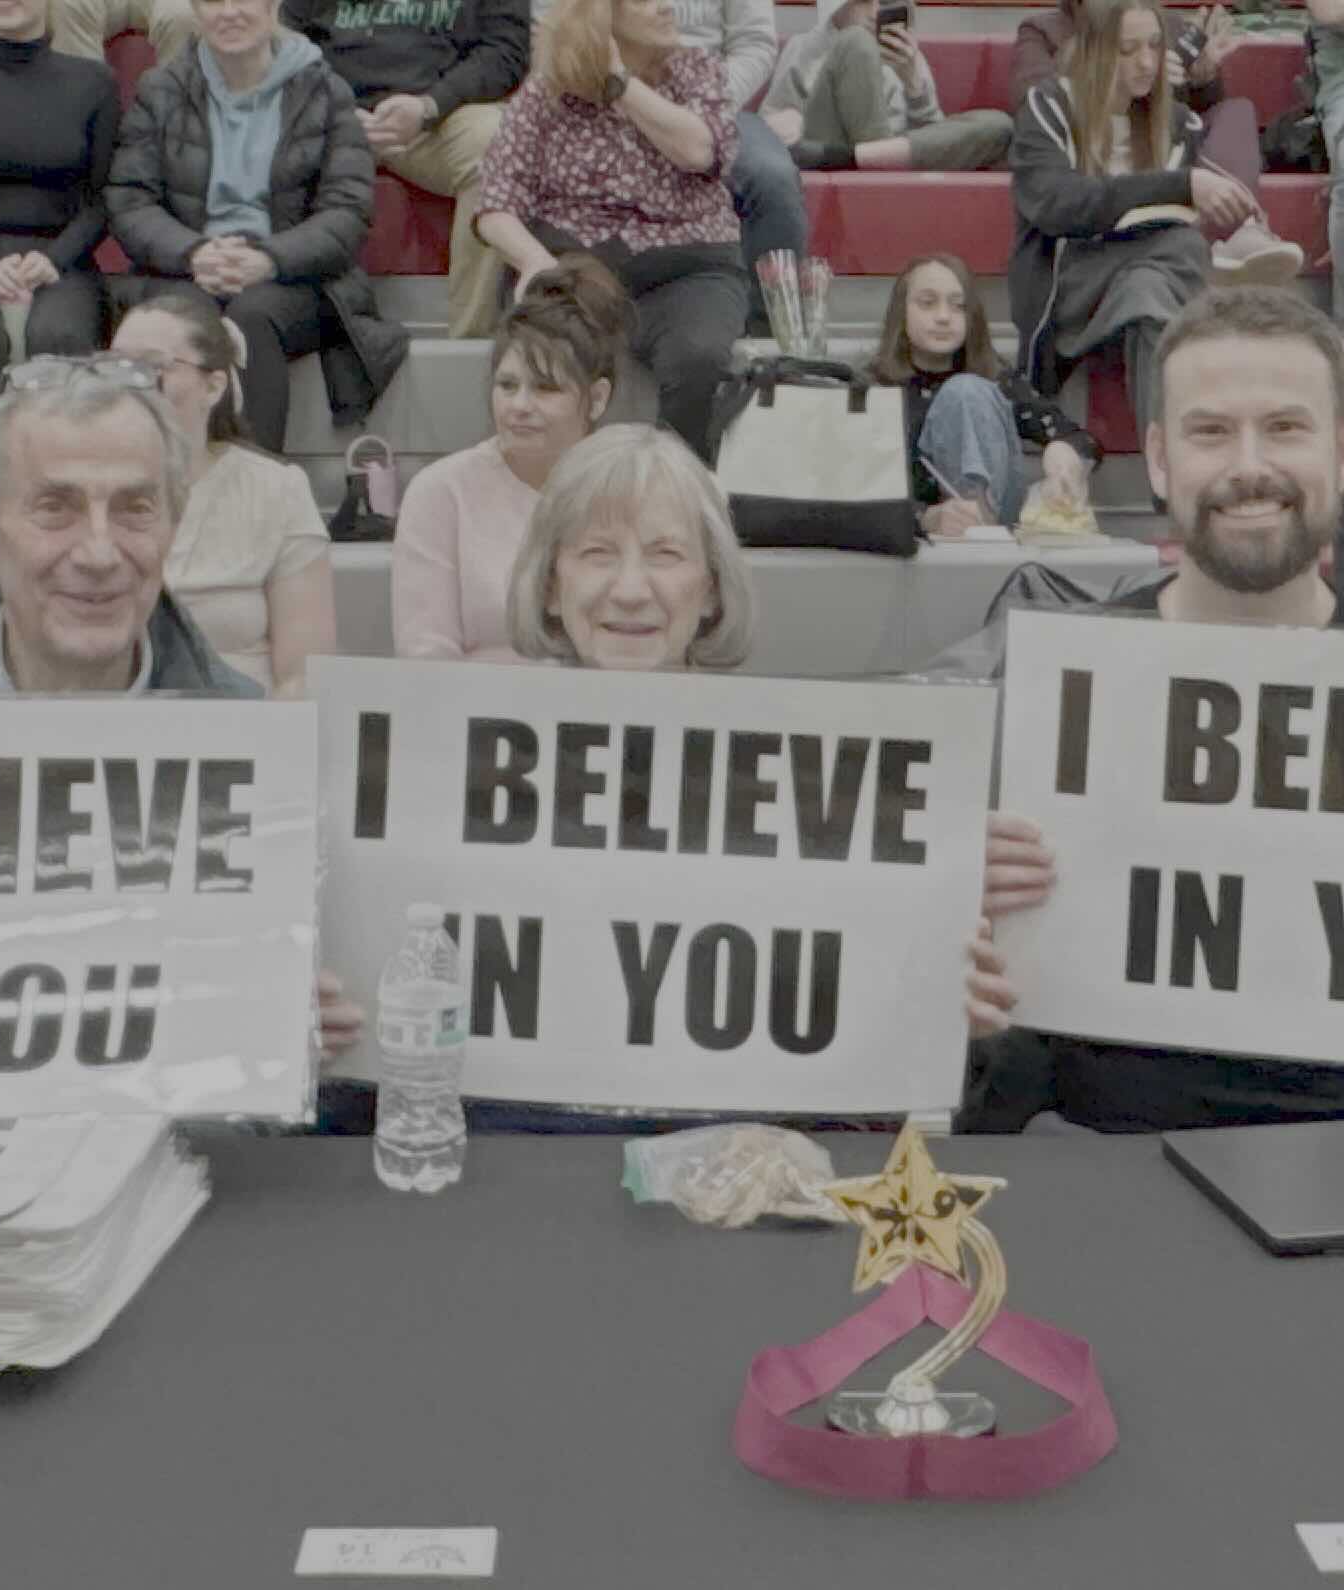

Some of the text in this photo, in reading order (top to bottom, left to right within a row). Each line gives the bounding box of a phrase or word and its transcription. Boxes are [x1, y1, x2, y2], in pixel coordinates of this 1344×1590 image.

[353, 711, 934, 866] I BELIEVE
[1055, 668, 1094, 796] I
[440, 912, 843, 1056] N YOU
[1124, 865, 1245, 994] IN
